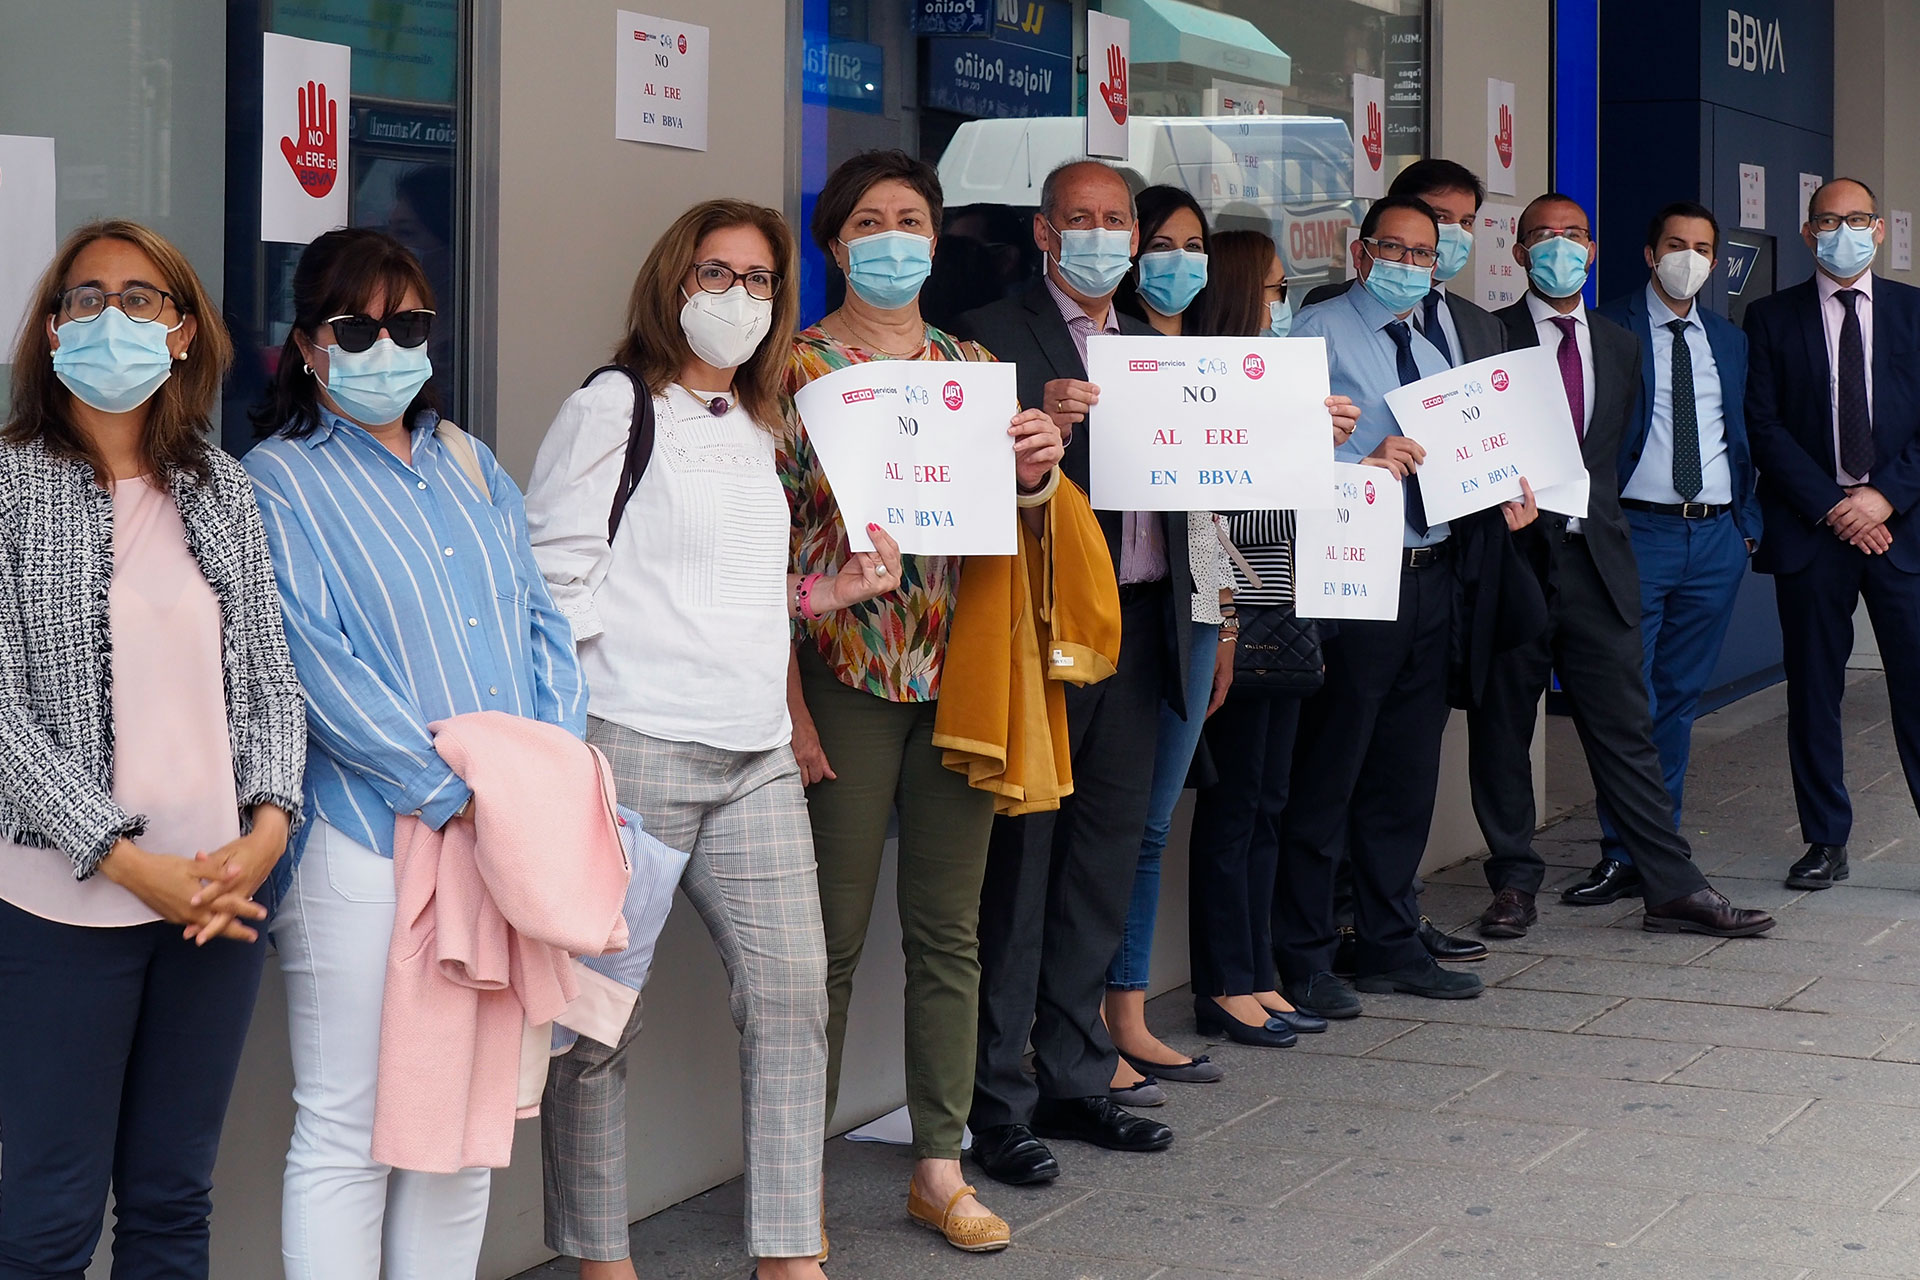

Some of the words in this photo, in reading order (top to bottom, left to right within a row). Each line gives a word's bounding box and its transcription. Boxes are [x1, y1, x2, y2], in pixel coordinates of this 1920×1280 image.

[1728, 9, 1785, 75] BBVA
[655, 53, 669, 68] NO
[644, 83, 656, 96] AL
[664, 86, 681, 100] ERE
[643, 112, 655, 124] EN
[662, 115, 683, 129] BBVA
[1239, 123, 1250, 136] NO
[308, 130, 324, 147] NO
[296, 154, 305, 166] AL
[305, 151, 326, 169] ERE
[327, 158, 337, 170] DE
[1245, 155, 1259, 168] ERE
[301, 169, 334, 186] BBVA
[1130, 361, 1157, 371] CCOO
[1158, 359, 1186, 367] servicios
[1245, 357, 1263, 369] UGT
[843, 389, 873, 403] CCOO
[872, 386, 898, 395] servicios
[944, 385, 961, 398] UGT
[1182, 385, 1217, 403] NO
[1423, 396, 1443, 409] CCOO
[1461, 405, 1481, 423] NO
[897, 415, 919, 436] NO
[1152, 429, 1183, 445] AL
[1205, 429, 1249, 445] ERE
[1455, 446, 1473, 462] AL
[1481, 432, 1509, 452] ERE
[885, 462, 904, 480] AL
[914, 465, 951, 483] ERE
[1150, 470, 1178, 485] EN
[1198, 470, 1253, 485] BBVA
[1461, 477, 1480, 494] EN
[1487, 464, 1519, 484] BBVA
[887, 507, 905, 524] EN
[915, 510, 954, 527] BBVA
[1337, 508, 1350, 523] NO
[1326, 546, 1338, 560] AL
[1343, 547, 1366, 561] ERE
[1324, 582, 1336, 596] EN
[1341, 583, 1367, 597] BBVA
[1244, 643, 1279, 651] VALENTINO
